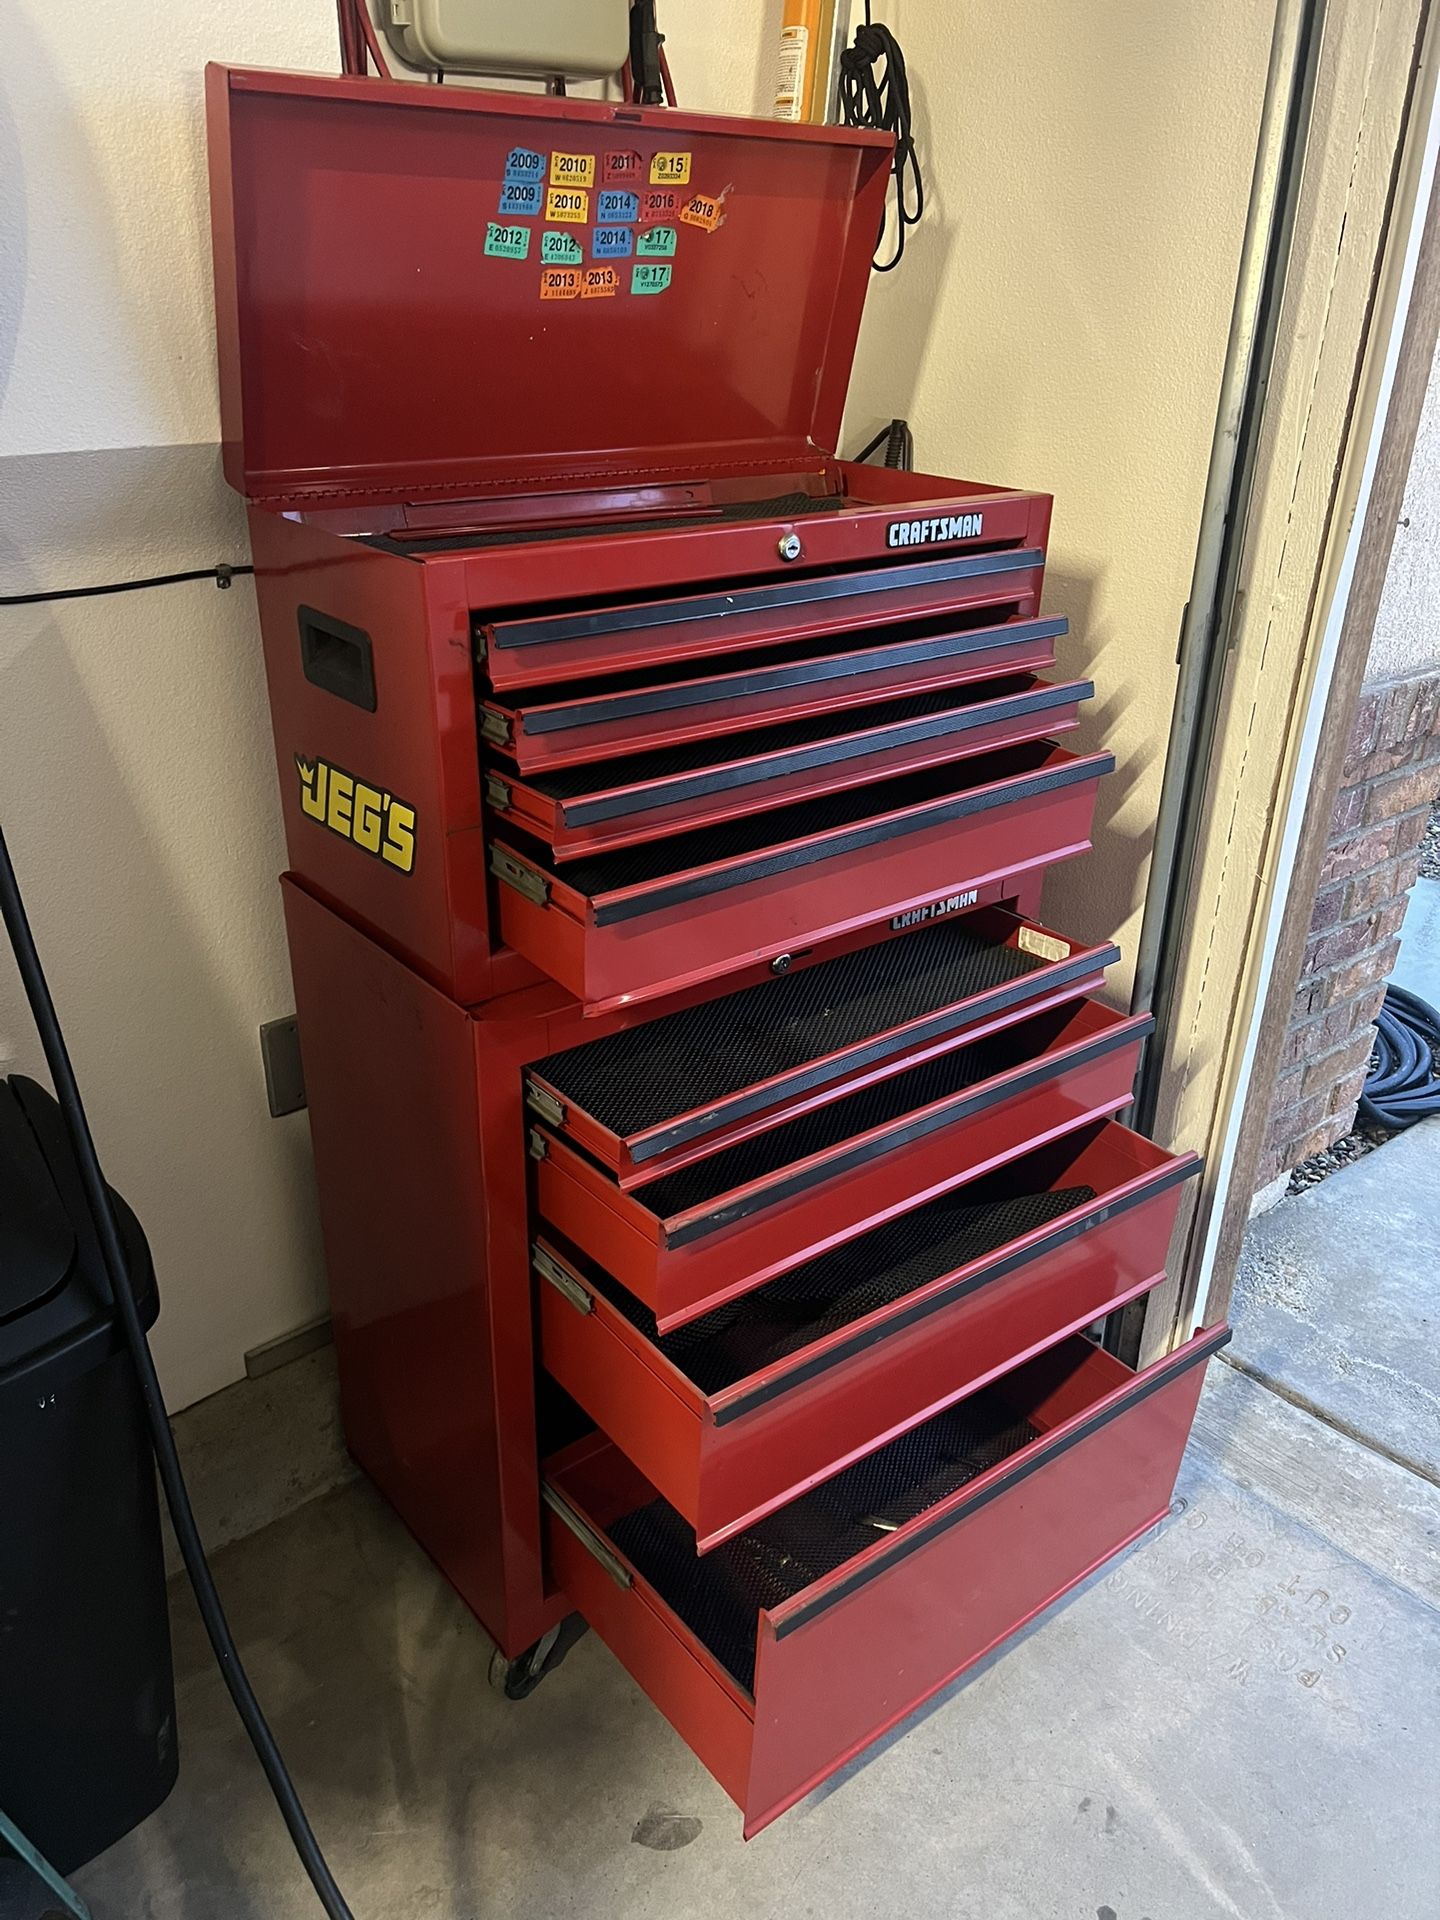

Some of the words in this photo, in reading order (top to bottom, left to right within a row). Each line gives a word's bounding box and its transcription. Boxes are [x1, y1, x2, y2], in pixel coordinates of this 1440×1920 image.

[510, 152, 540, 169] 2009
[559, 157, 587, 173] 2010
[611, 155, 636, 170] 2011
[669, 157, 684, 172] 15
[507, 185, 535, 201] 2009
[554, 194, 581, 209] 2010
[605, 195, 631, 209] 2014
[649, 194, 674, 208] 2016
[689, 199, 714, 217] 2018
[494, 228, 522, 245] 2012
[600, 230, 626, 244] 2014
[656, 230, 671, 244] 17
[549, 237, 577, 252] 2012
[548, 273, 575, 287] 2013
[588, 270, 613, 286] 2013
[651, 267, 667, 281] 17
[888, 513, 984, 547] CRAFTSMAN
[301, 761, 415, 873] JEG'S
